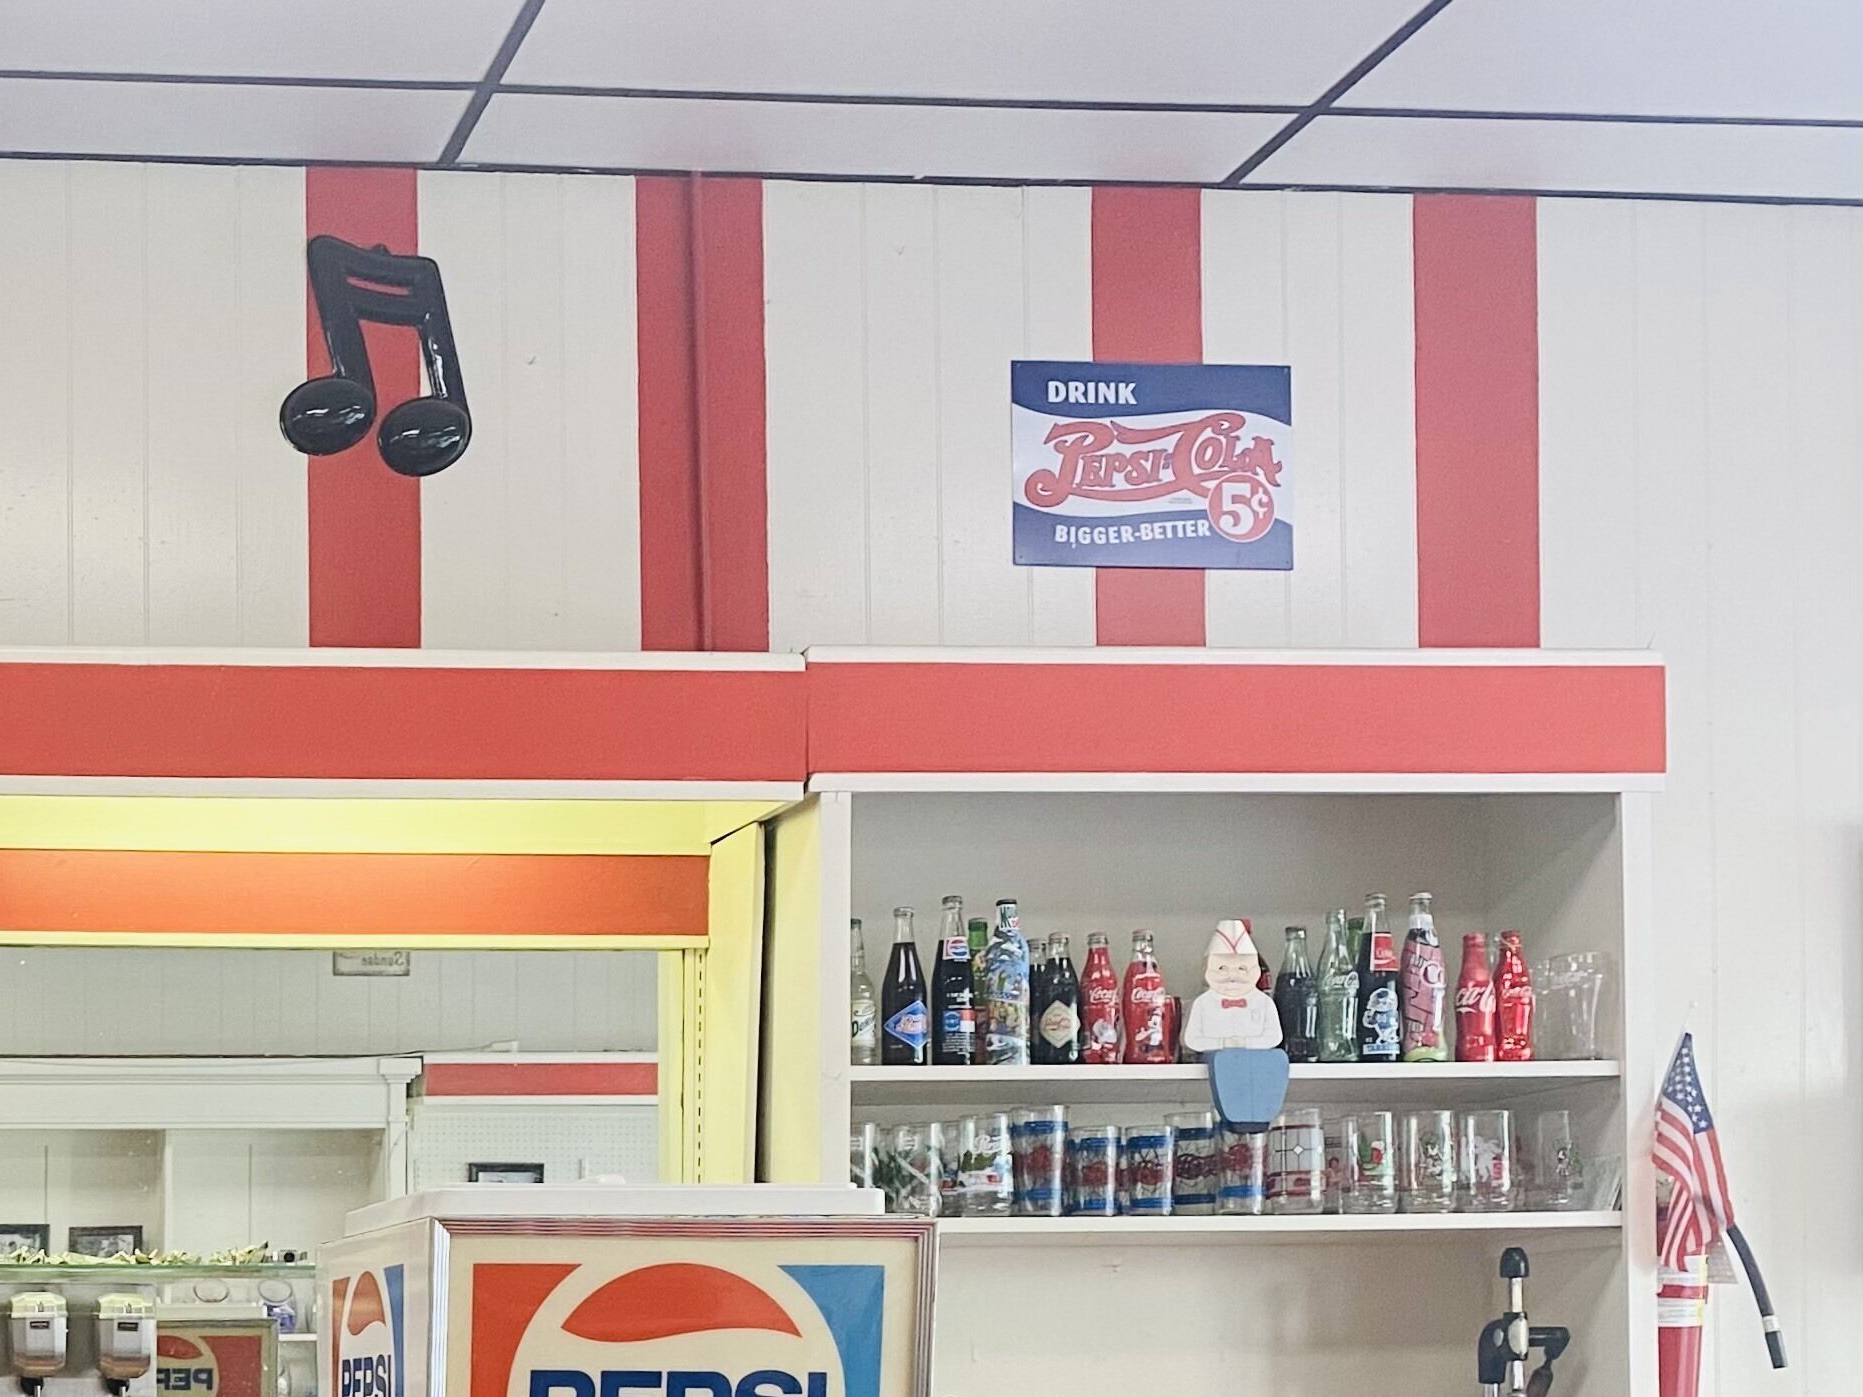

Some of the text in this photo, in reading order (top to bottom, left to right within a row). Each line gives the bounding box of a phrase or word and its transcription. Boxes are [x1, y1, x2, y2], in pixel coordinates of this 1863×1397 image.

[1047, 380, 1137, 405] DRINK
[1219, 482, 1269, 535] 5¢
[1055, 520, 1211, 545] BIGGER-BETTER
